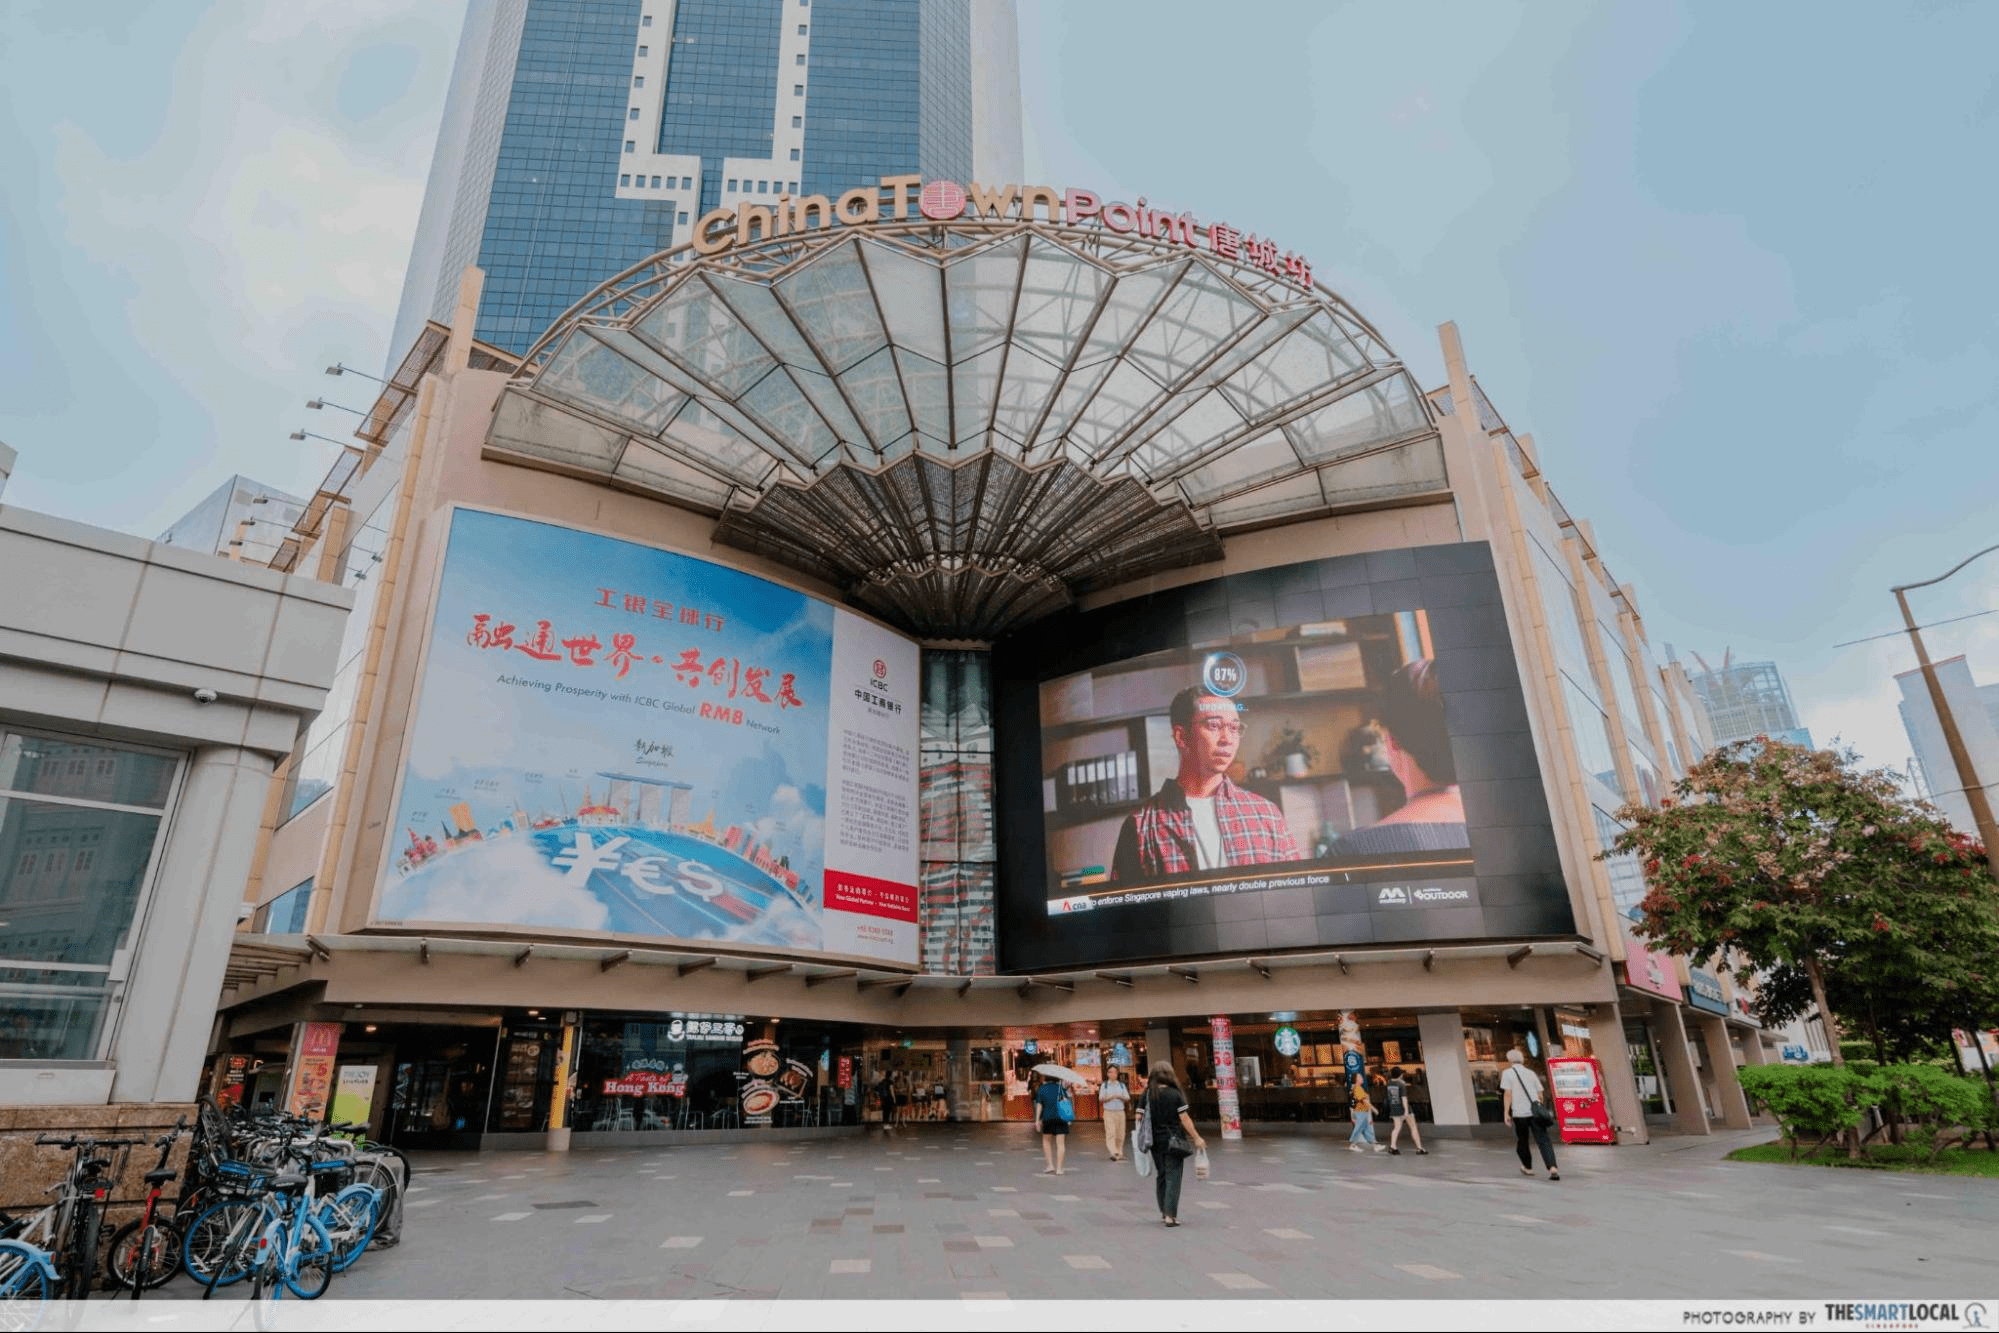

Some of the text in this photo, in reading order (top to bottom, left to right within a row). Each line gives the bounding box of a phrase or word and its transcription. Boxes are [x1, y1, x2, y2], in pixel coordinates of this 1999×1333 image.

[870, 678, 889, 692] ICBC
[1214, 667, 1237, 681] 87%
[497, 673, 781, 736] Achieving Prosperity with ICBC Global RMB Network
[854, 689, 902, 716] 中国工商银行
[1098, 896, 1123, 906] enforce
[1125, 892, 1161, 904] Singapore
[1163, 888, 1189, 899] vaping
[1190, 886, 1210, 894] laws,
[1212, 882, 1238, 893] nearly
[1239, 880, 1267, 890] double
[1269, 876, 1306, 888] previous
[1307, 874, 1330, 884] force
[604, 1080, 685, 1098] Hong Kong
